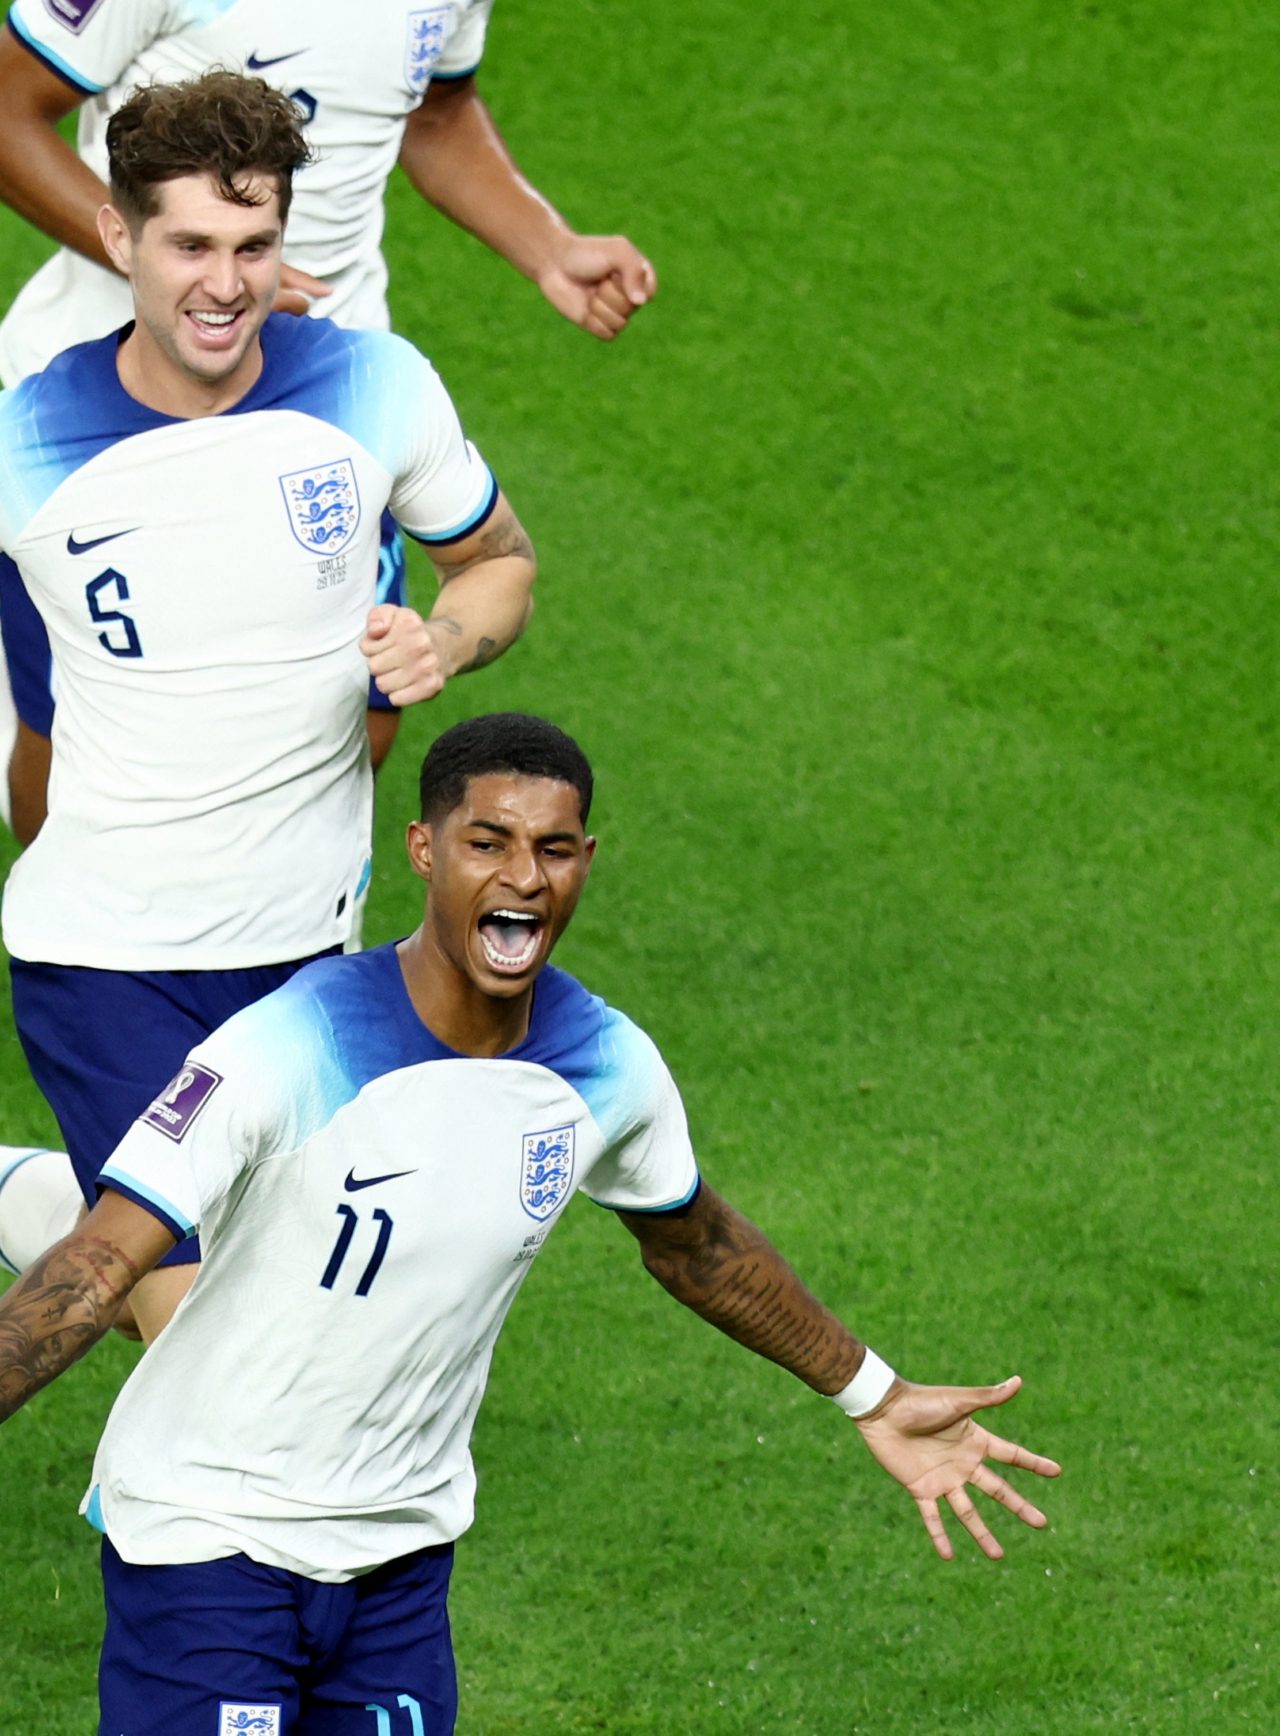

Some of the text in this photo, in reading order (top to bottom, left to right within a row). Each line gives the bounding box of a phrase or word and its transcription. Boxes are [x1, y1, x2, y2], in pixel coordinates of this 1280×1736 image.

[317, 556, 347, 575] WALES
[85, 566, 143, 658] 5
[320, 1203, 394, 1297] 11
